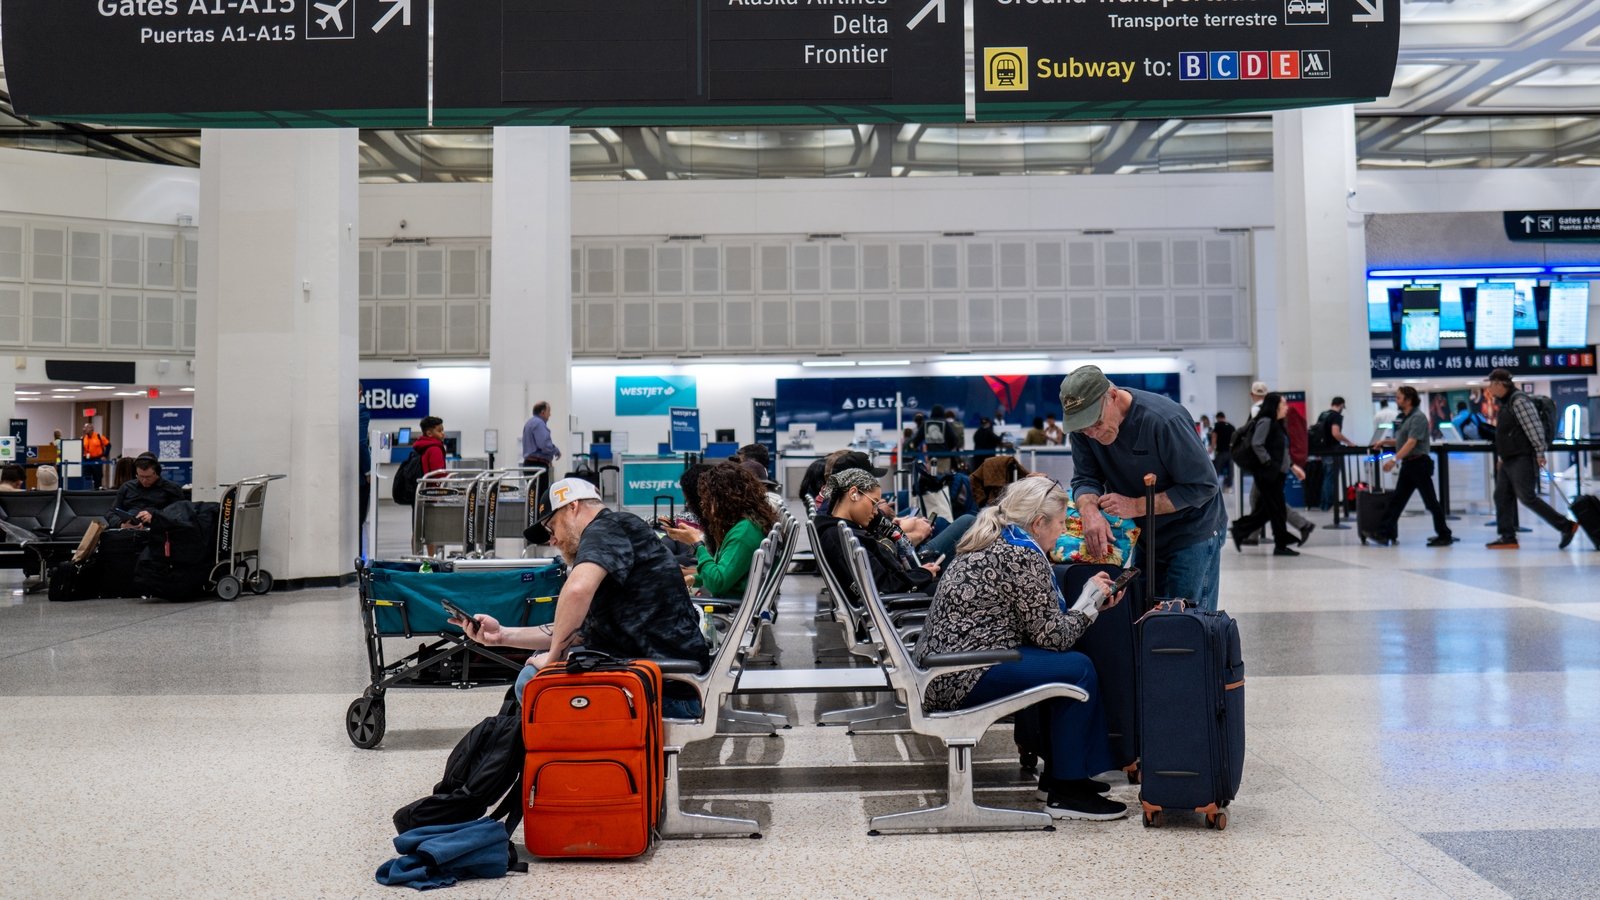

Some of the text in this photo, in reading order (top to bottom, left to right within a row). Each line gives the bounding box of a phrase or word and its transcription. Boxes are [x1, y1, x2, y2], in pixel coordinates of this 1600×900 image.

[97, 0, 296, 17] Gates A1-A15
[833, 14, 888, 34] Delta
[1108, 13, 1278, 31] Transporte terrestre
[140, 25, 296, 44] Puertas A1-A15
[804, 44, 888, 64] Frontier
[1037, 53, 1292, 83] Subway to: B C D E
[1558, 216, 1581, 224] Gates
[1393, 356, 1422, 370] Gates
[1424, 356, 1436, 369] A1
[1445, 355, 1462, 369] A15
[1474, 354, 1489, 368] All
[1491, 353, 1519, 367] Gates
[360, 388, 418, 409] tBlue
[620, 386, 664, 398] WESTJET
[553, 486, 569, 503] T
[629, 480, 673, 491] WESTJET
[222, 498, 232, 551] smartecarte
